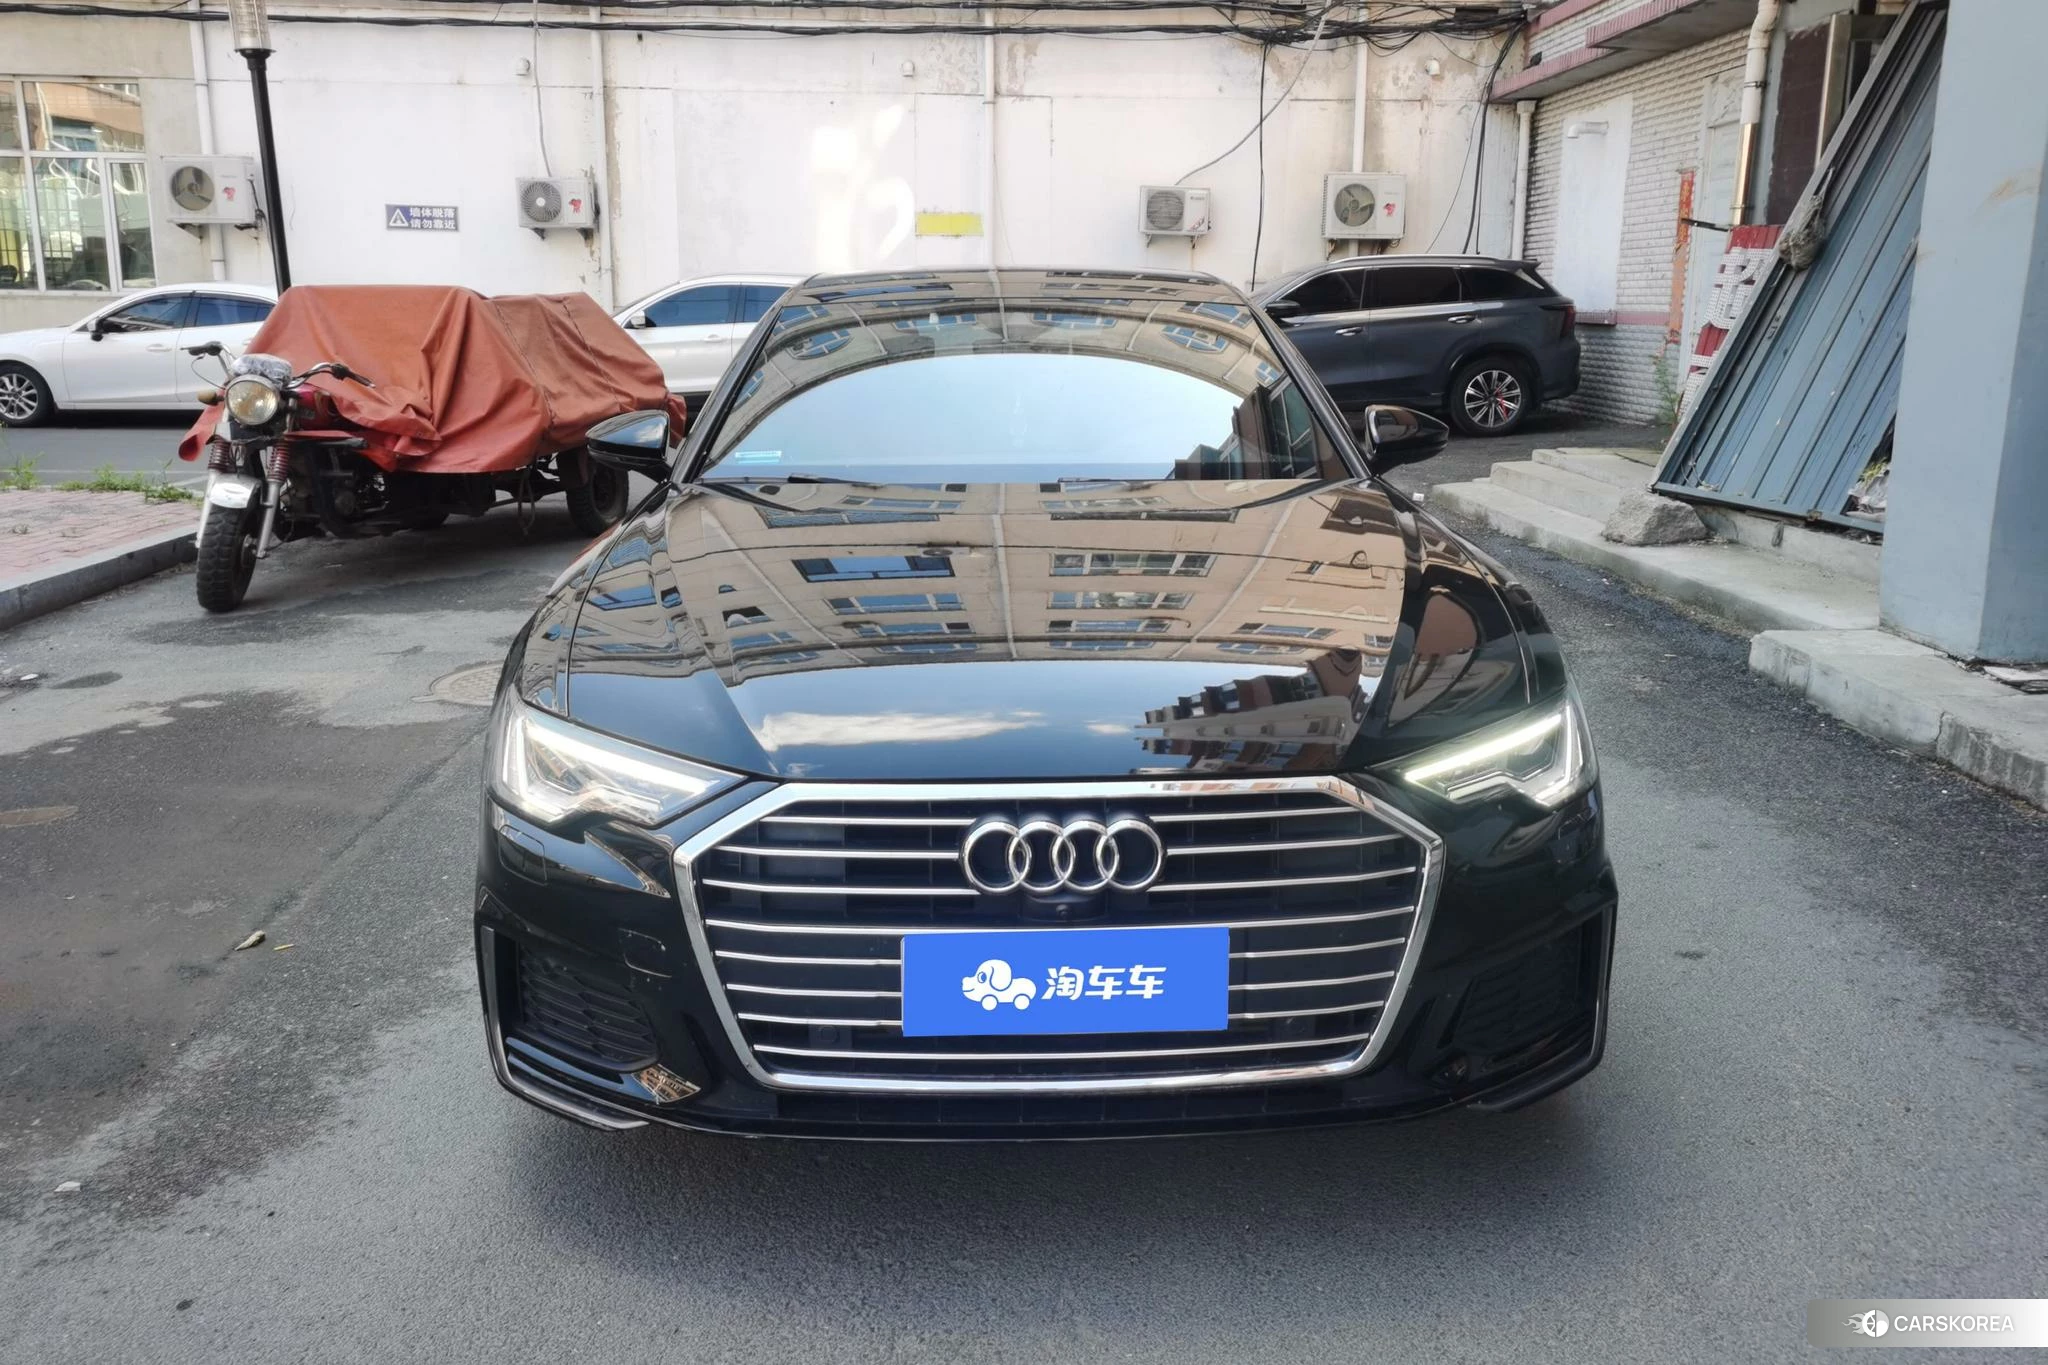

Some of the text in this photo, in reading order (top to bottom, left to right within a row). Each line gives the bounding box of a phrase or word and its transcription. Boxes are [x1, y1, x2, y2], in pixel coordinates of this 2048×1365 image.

[410, 207, 455, 218] 墙体脱落
[410, 218, 456, 229] 请勿靠近
